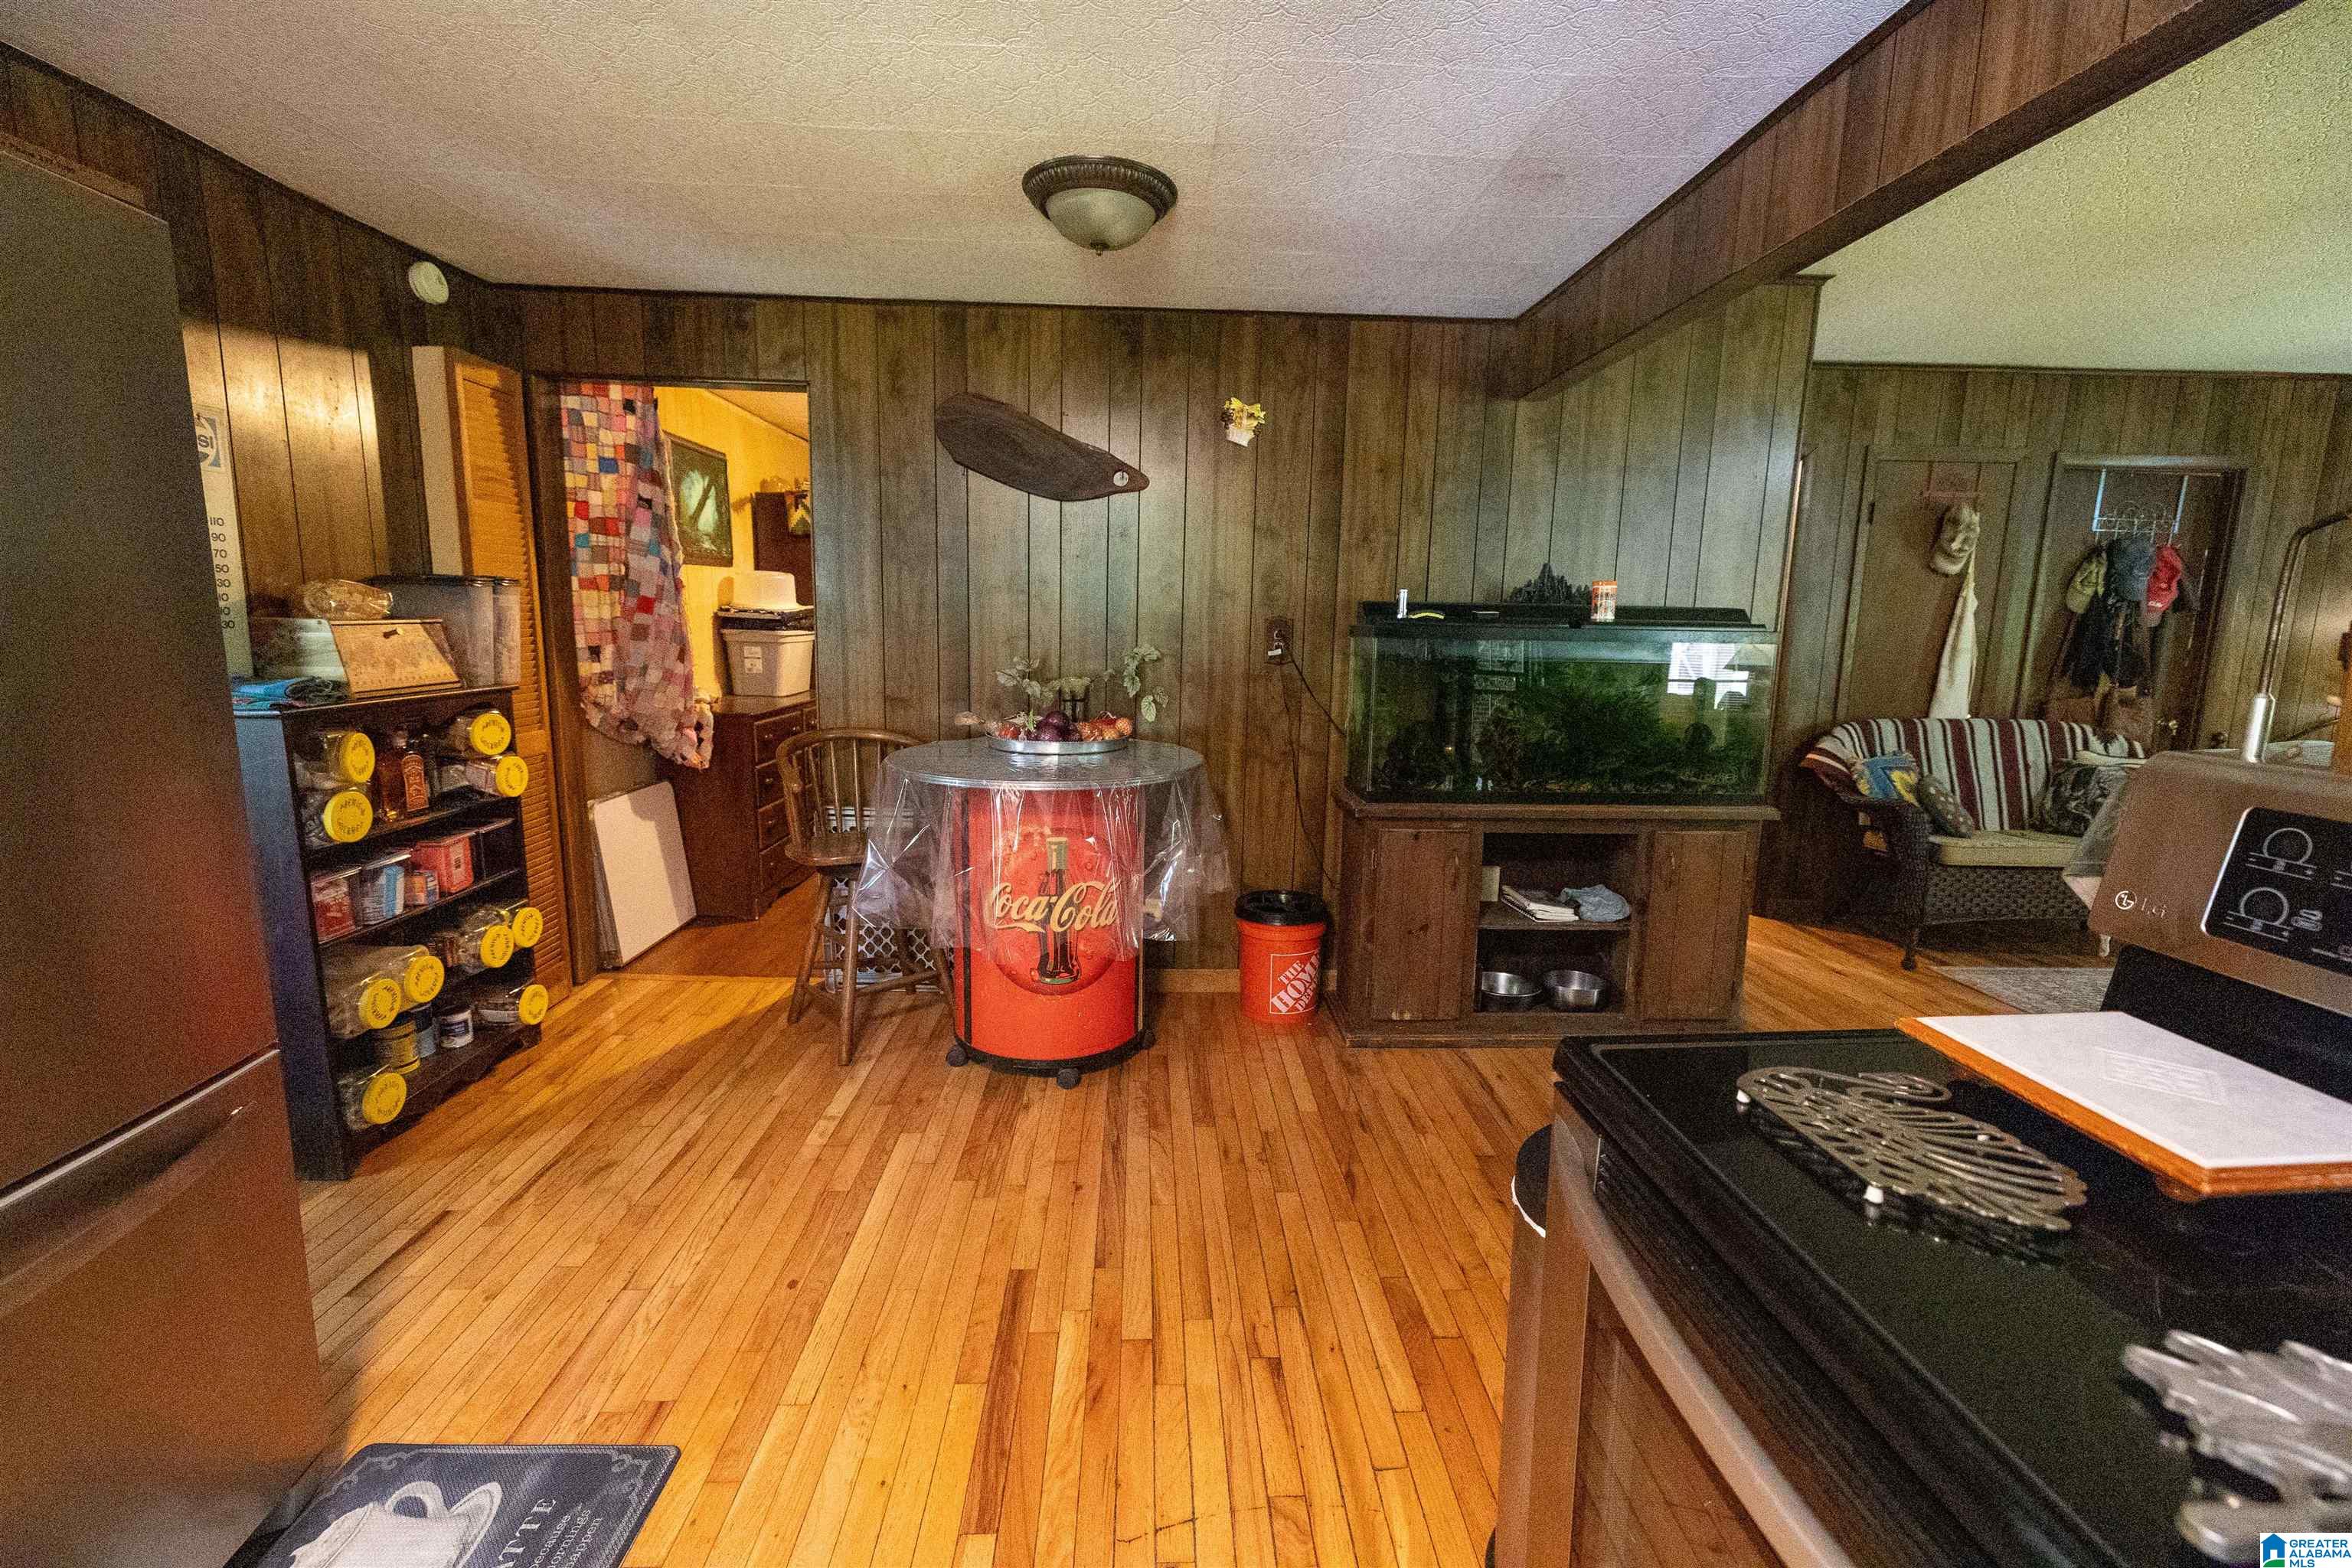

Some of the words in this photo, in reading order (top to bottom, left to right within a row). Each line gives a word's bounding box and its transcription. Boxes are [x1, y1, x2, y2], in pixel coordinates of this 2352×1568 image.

[211, 532, 227, 542] 90
[213, 548, 228, 558] 70
[215, 564, 230, 573] 50
[217, 578, 231, 588] 30
[984, 880, 1119, 933] Coca-Cola
[1278, 960, 1305, 985] THE
